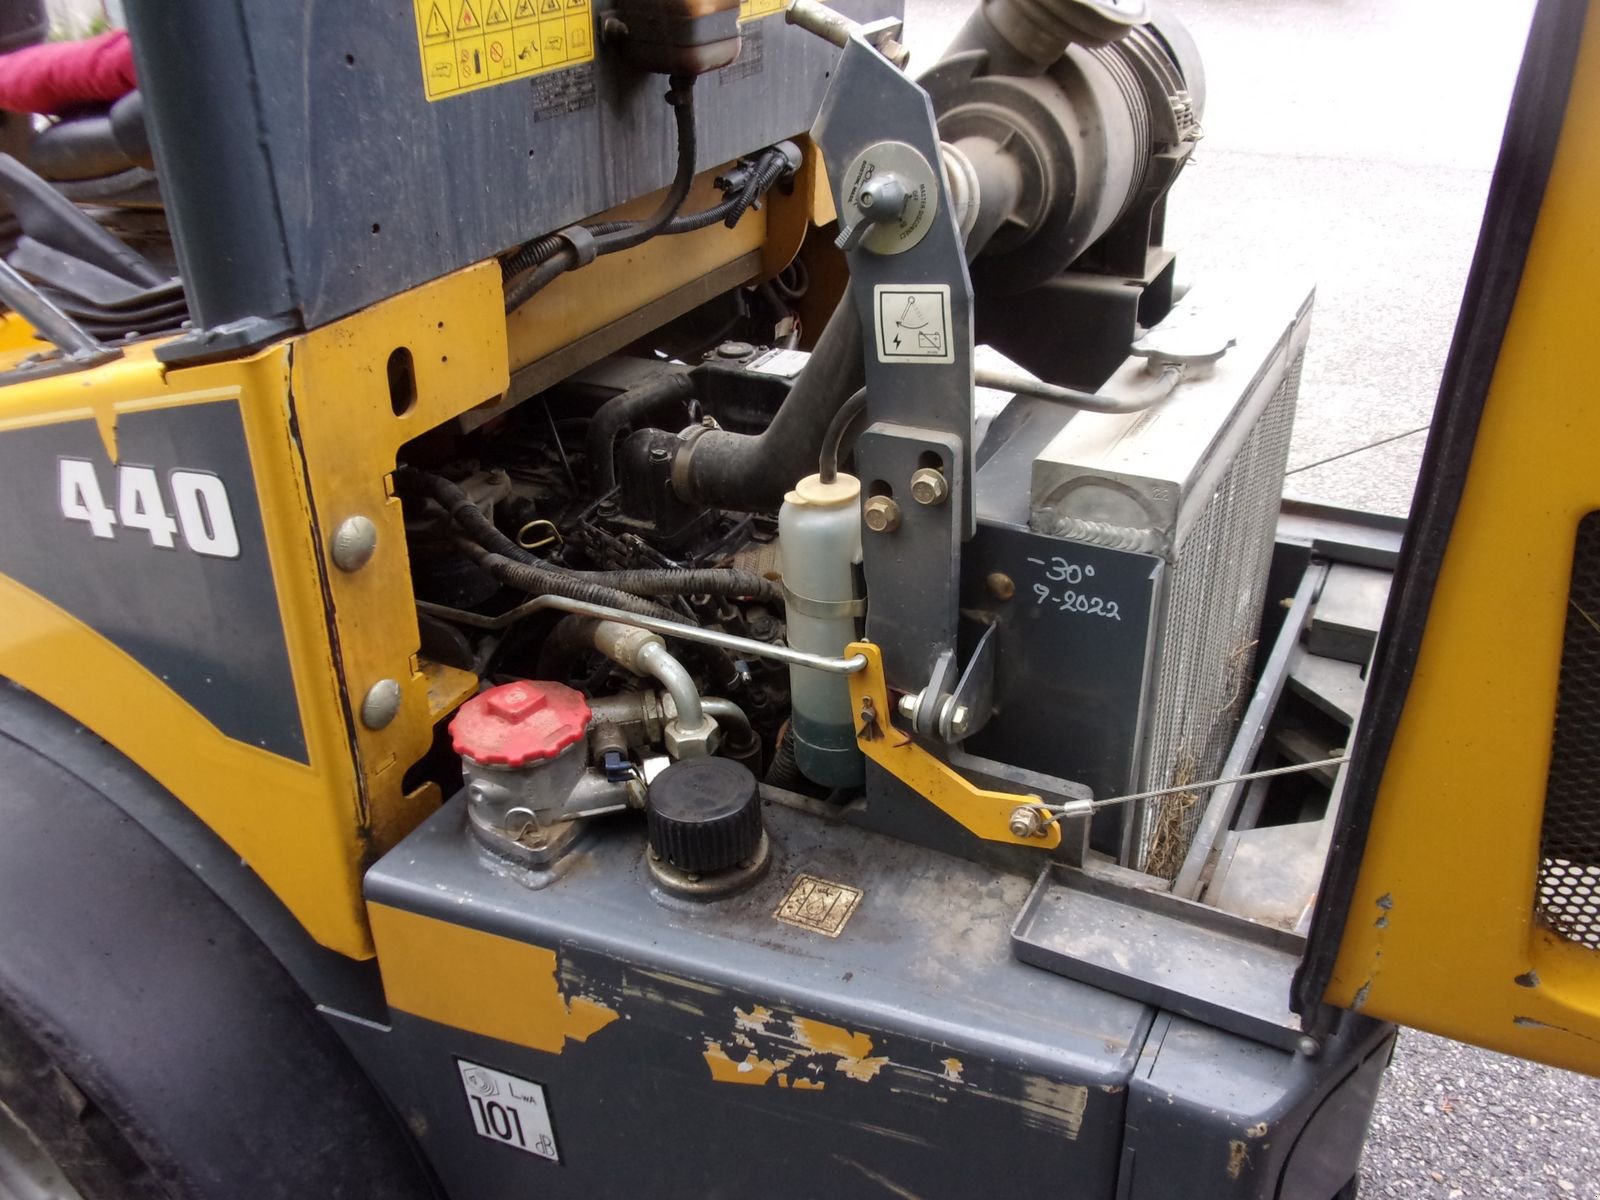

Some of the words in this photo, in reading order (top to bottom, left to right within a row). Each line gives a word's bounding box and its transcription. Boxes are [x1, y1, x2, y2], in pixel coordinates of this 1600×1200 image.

[60, 459, 240, 558] 440
[1033, 583, 1121, 621] 9-2022
[471, 1094, 526, 1147] 101
[535, 1133, 555, 1157] dB
